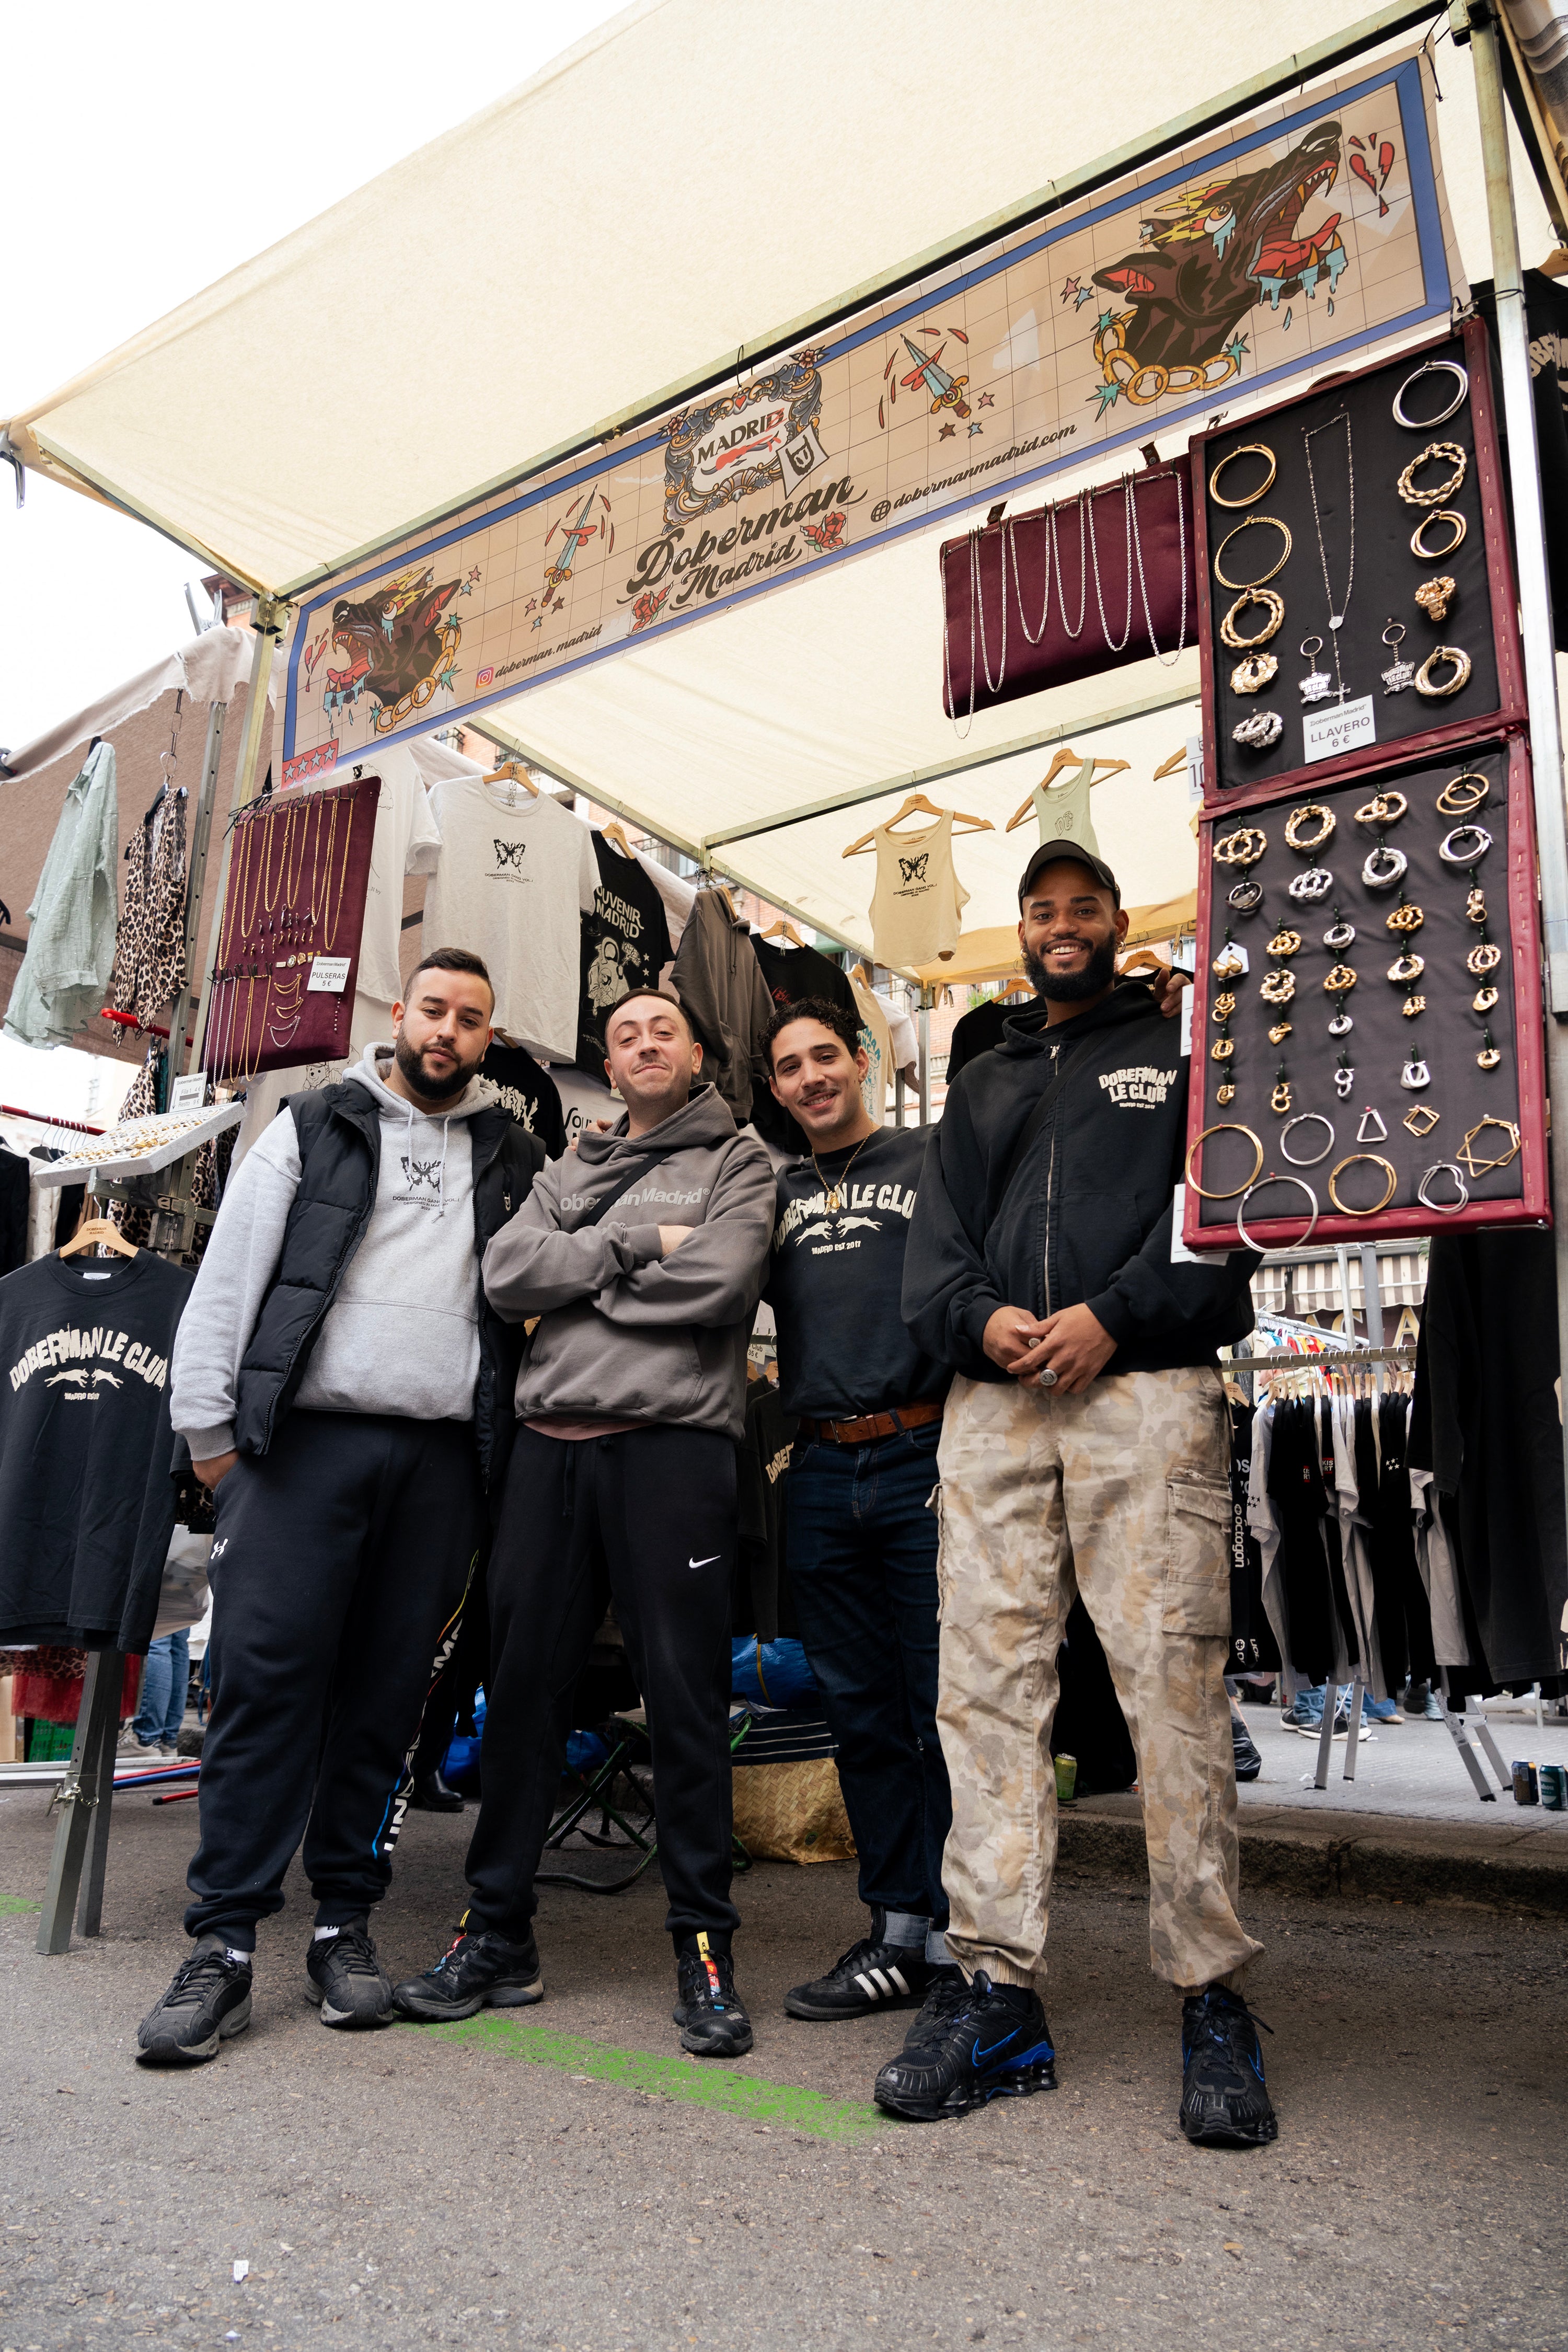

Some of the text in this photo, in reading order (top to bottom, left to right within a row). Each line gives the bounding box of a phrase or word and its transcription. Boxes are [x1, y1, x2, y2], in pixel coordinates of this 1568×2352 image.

[697, 408, 786, 465] MADRID
[893, 424, 1078, 510] dobermanmadrid.com
[618, 476, 866, 603] Doberman
[671, 535, 801, 608] Madrid
[494, 624, 603, 678] doberman.madrid
[1309, 713, 1343, 727] Doberman
[1311, 717, 1370, 743] LLAVERO
[1332, 735, 1350, 747] 6 €
[596, 886, 644, 929] OUVENIR
[596, 899, 640, 939] MADRID
[1098, 1065, 1178, 1089] DOBERMAN
[1109, 1083, 1167, 1103] LE CLUB
[851, 1184, 877, 1210] LE
[877, 1183, 917, 1219] CLU
[812, 1244, 833, 1254] MADRID
[846, 1240, 861, 1250] 2017
[9, 1323, 103, 1392] DOBERMAN
[100, 1330, 129, 1362] LE
[1232, 1516, 1244, 1567] octogon
